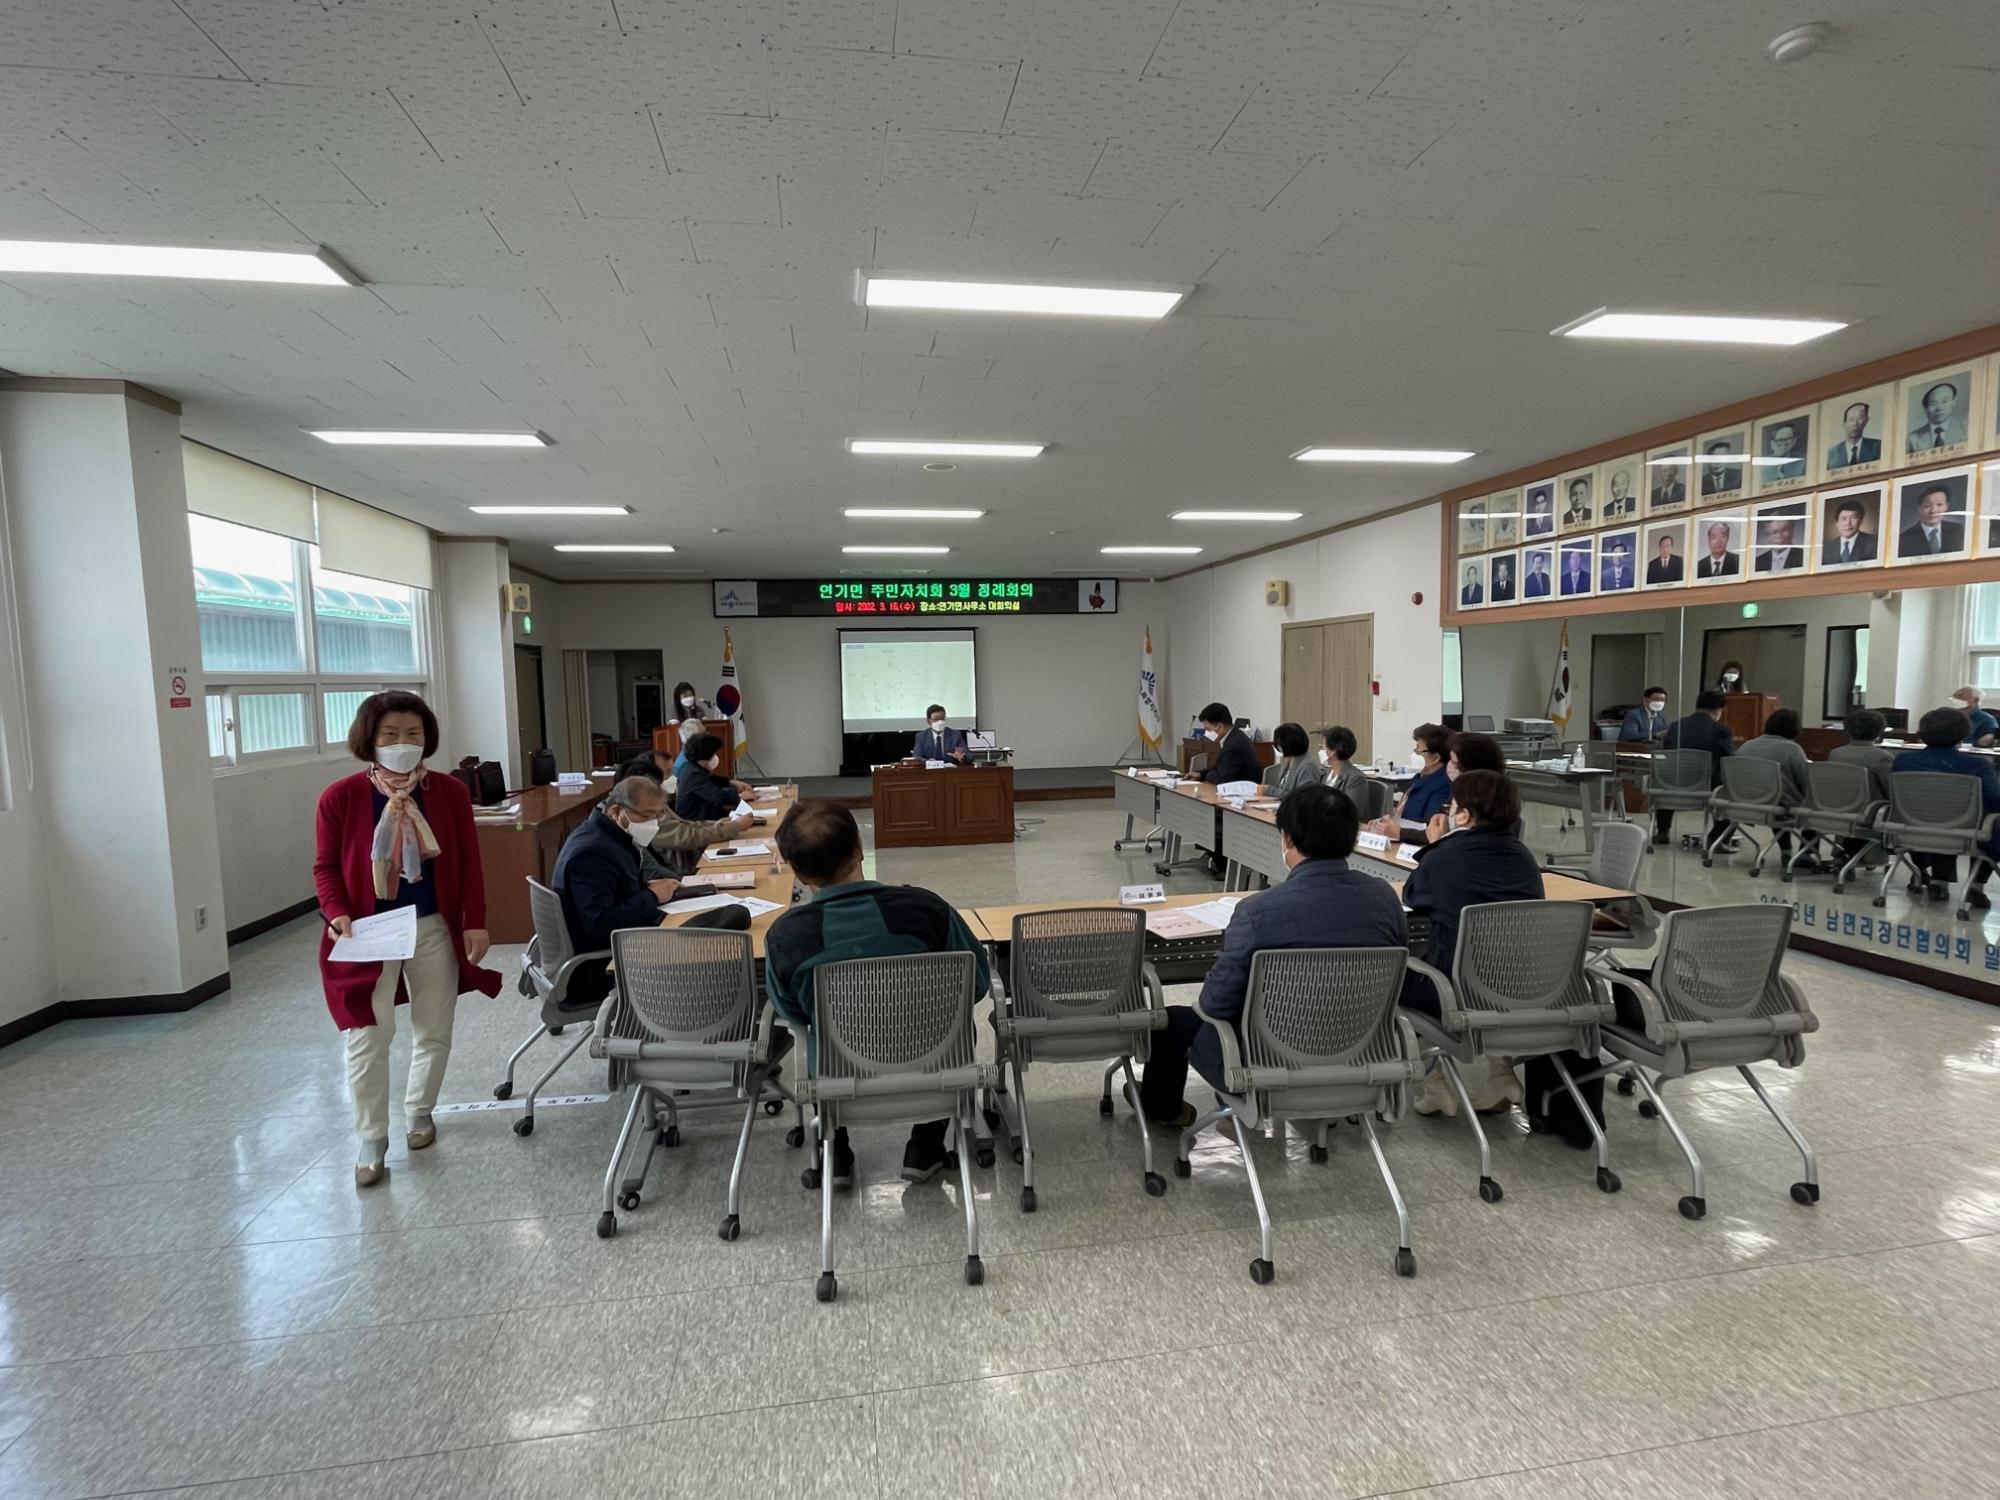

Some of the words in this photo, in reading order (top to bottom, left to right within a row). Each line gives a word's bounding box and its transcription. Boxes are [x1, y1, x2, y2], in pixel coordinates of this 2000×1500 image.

[820, 583, 863, 599] 연기면
[871, 583, 943, 599] 주민자치회
[949, 583, 971, 598] 3월
[978, 583, 1033, 598] 정례회의
[988, 601, 1020, 611] 대회의실
[1826, 908, 1970, 965] 남면리장단협의회
